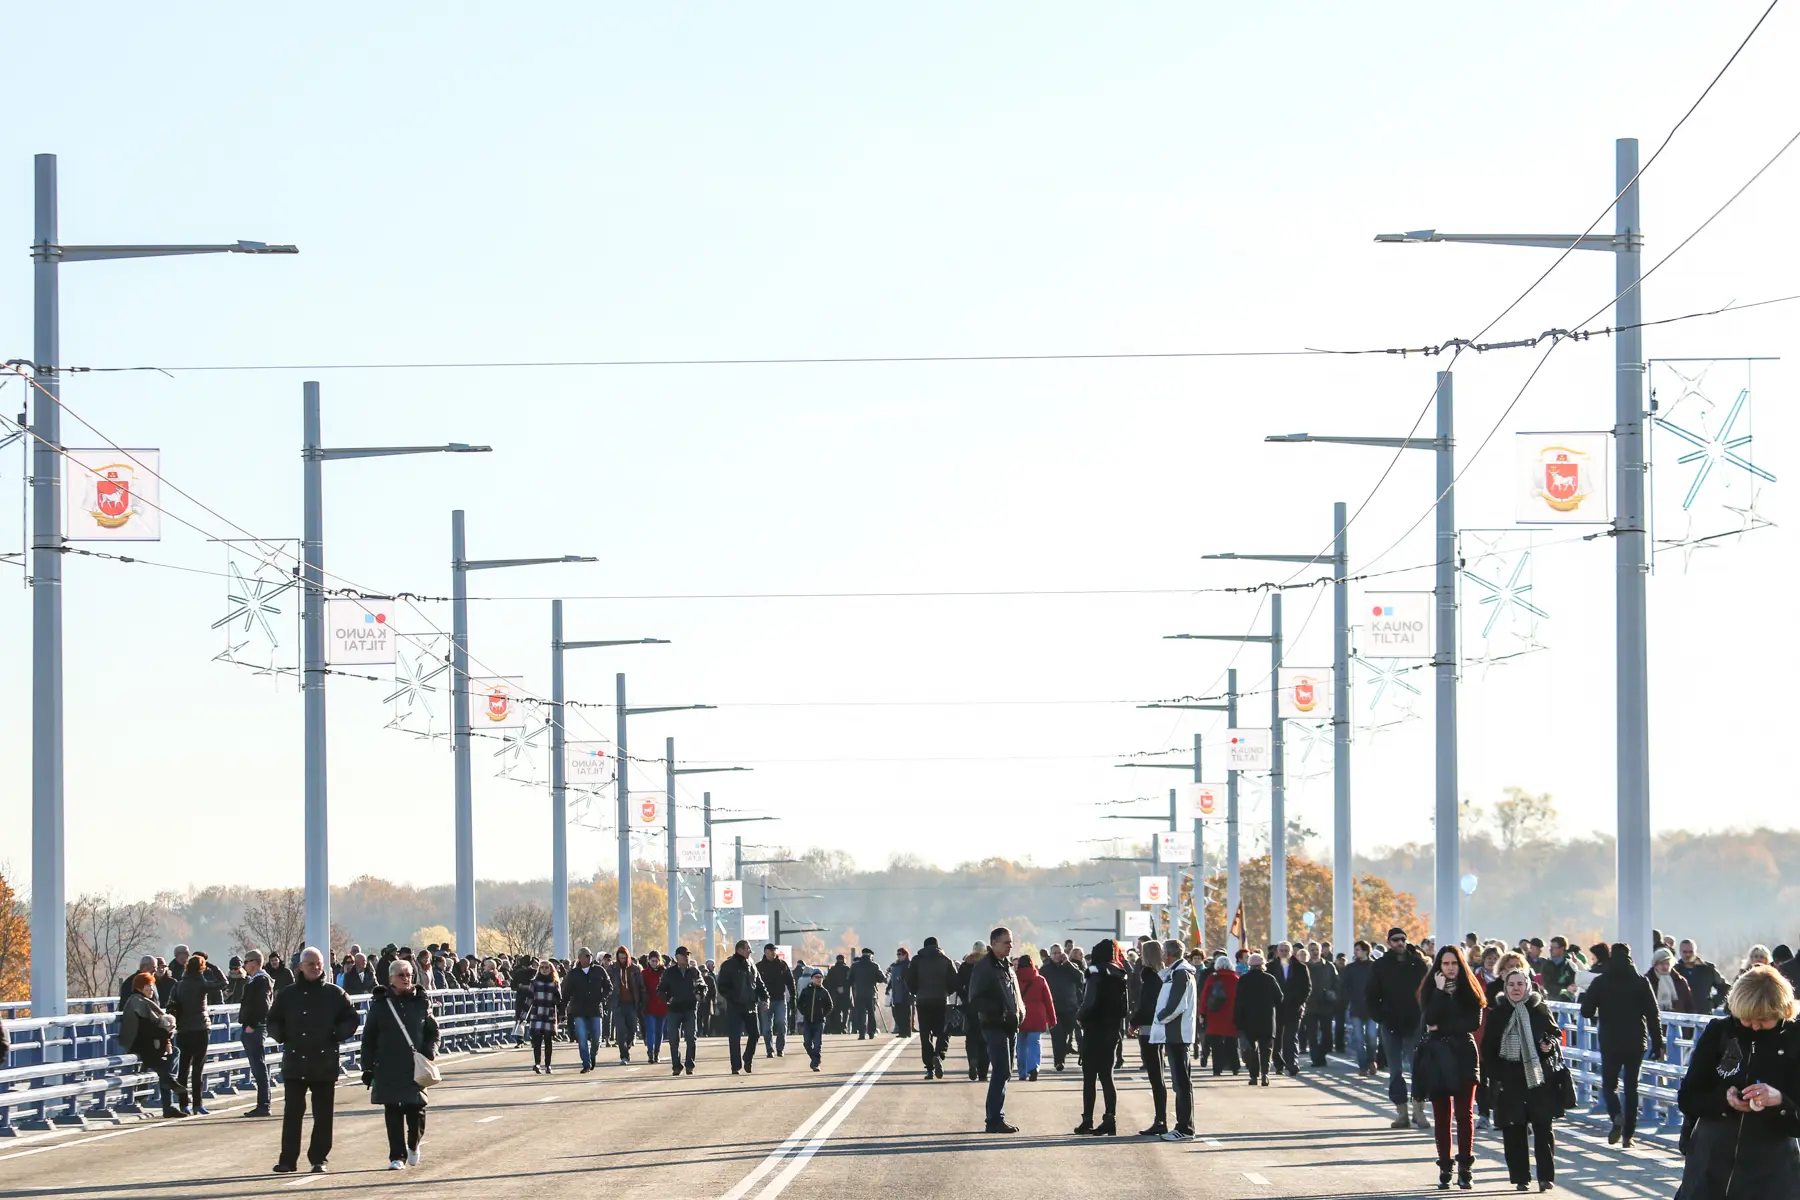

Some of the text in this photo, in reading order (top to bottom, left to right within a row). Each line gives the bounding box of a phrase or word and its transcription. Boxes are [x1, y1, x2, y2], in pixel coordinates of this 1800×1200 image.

[1371, 620, 1424, 631] KAUNO
[1372, 632, 1415, 644] TILTAI
[1231, 754, 1259, 762] TILTAI
